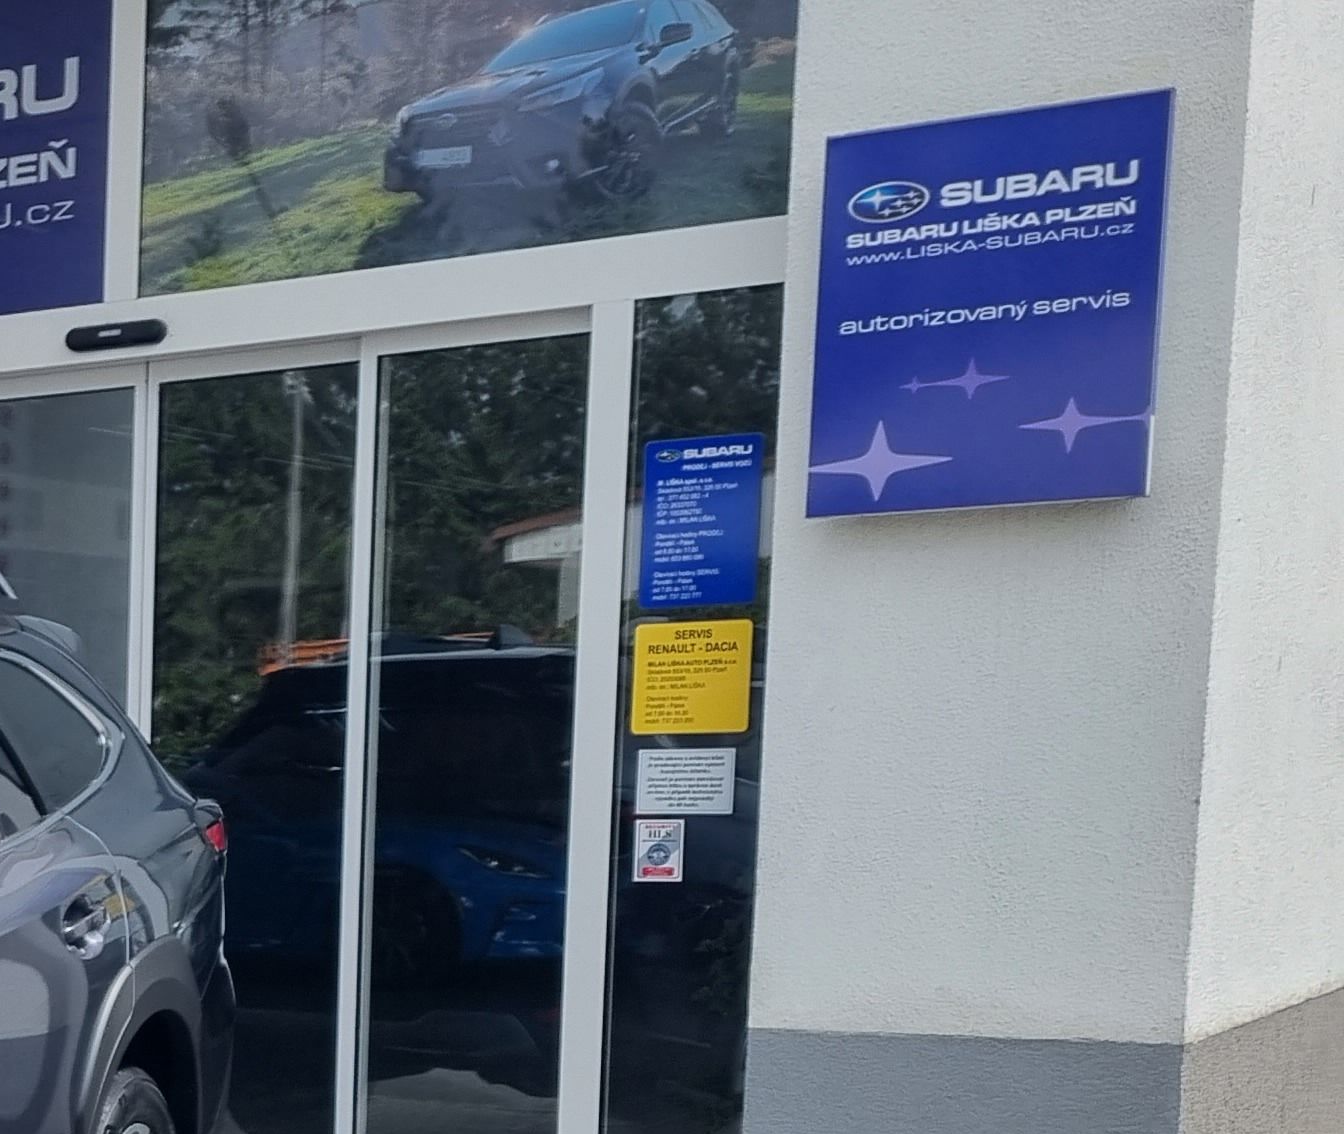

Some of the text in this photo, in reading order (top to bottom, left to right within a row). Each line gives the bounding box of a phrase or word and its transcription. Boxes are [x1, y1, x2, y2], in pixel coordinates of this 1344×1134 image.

[940, 159, 1140, 207] SUBARU
[846, 196, 1137, 249] SUBARU LIŠKA PLZEŇ
[846, 222, 1135, 266] www.LISKA-SUBARU.cz
[839, 289, 1131, 336] autorizovaný servis
[682, 444, 753, 459] SUBARU
[647, 643, 696, 655] RENAULT
[705, 642, 739, 653] DACIA
[674, 628, 713, 640] SERVIS
